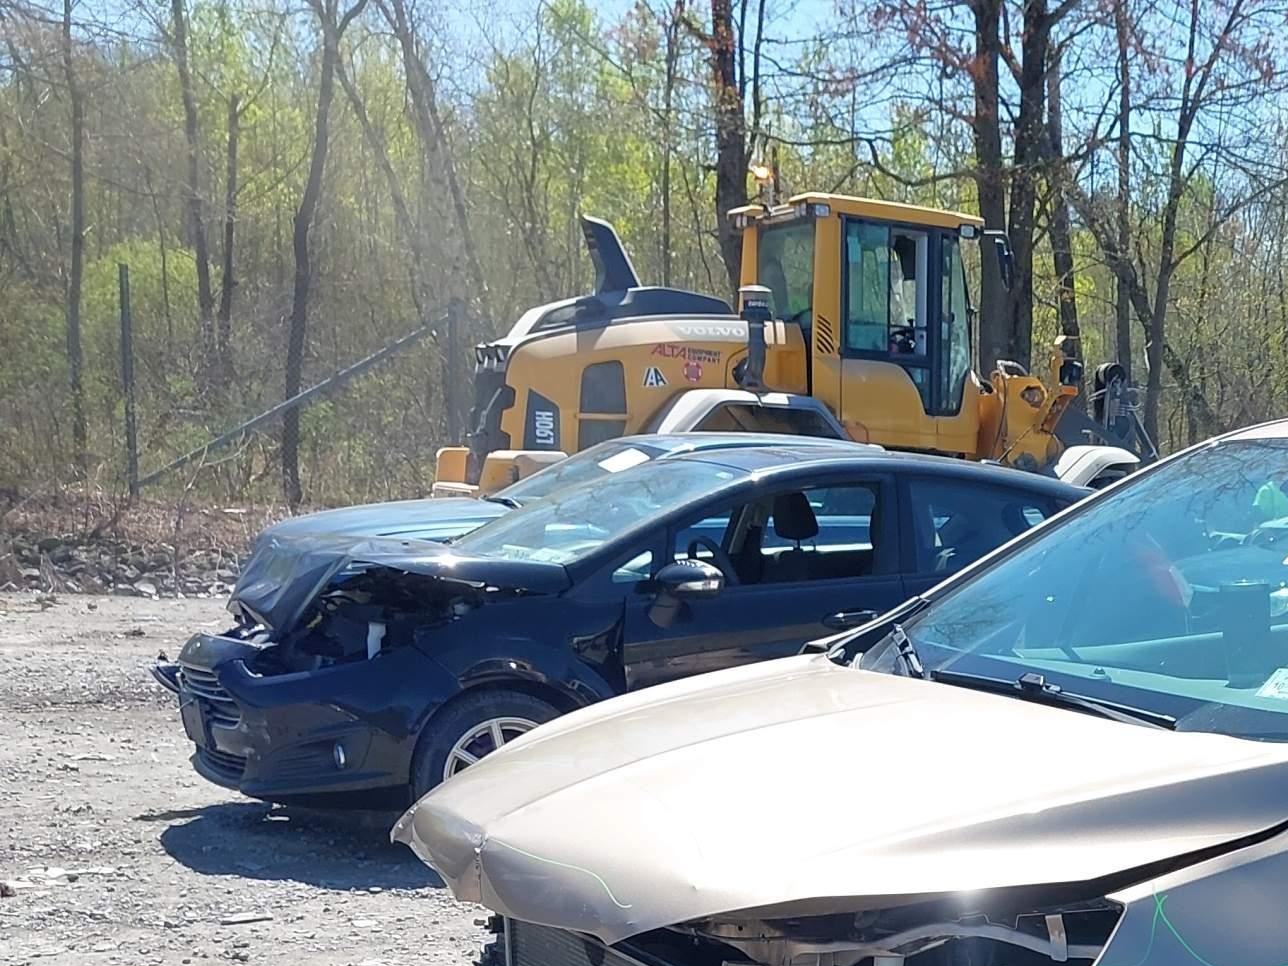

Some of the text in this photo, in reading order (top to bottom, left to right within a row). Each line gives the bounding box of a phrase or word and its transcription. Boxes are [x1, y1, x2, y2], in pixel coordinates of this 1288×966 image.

[680, 325, 746, 337] VOLVO
[651, 343, 687, 360] ALTA
[535, 410, 554, 445] L90H
